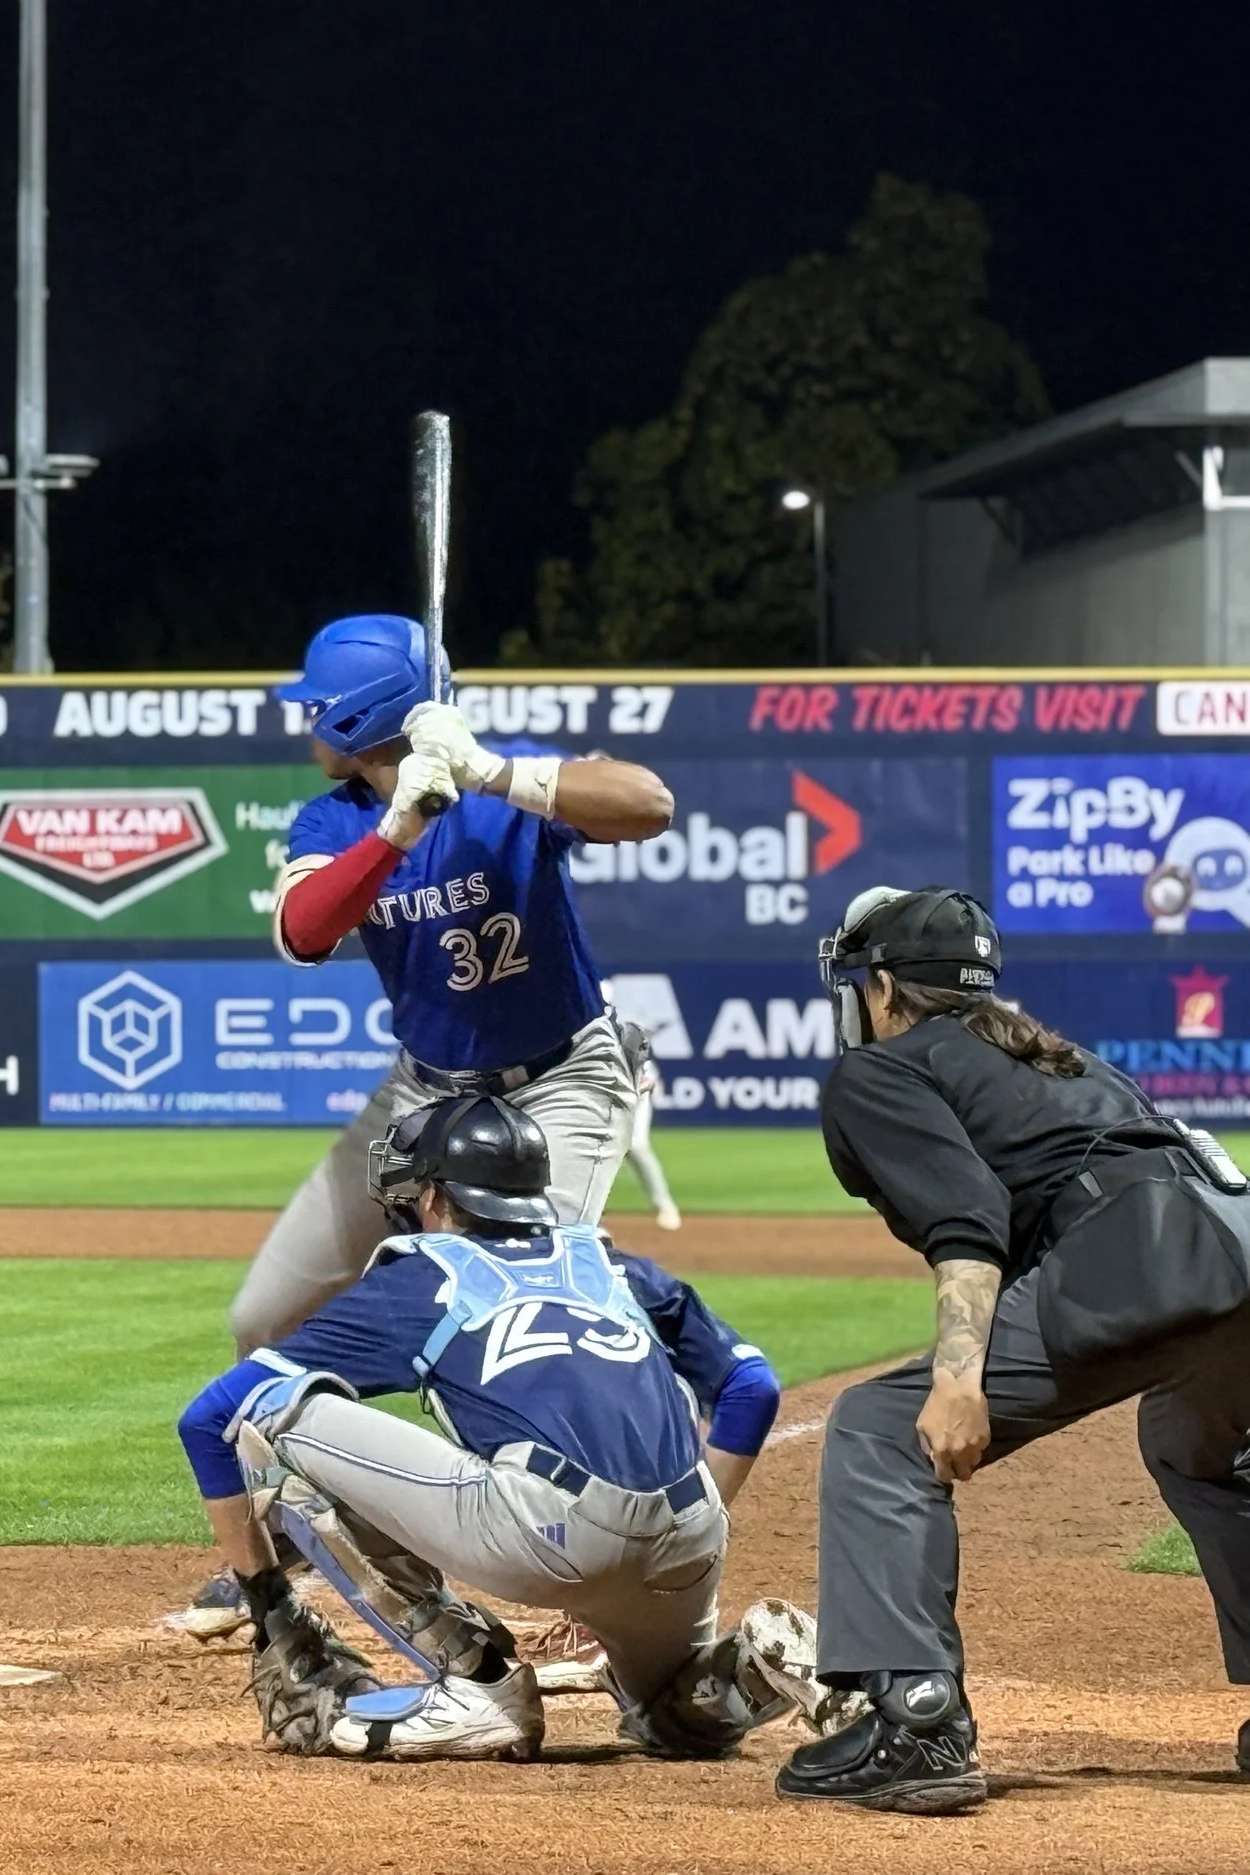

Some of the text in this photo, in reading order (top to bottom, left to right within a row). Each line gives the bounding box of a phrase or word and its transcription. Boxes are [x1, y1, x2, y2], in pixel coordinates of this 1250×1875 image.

[53, 690, 266, 737] AUGUST
[280, 700, 314, 736] 1
[456, 685, 597, 734] GUST
[608, 685, 674, 734] 27
[750, 685, 1147, 732] FOR TICKETS VISIT
[16, 807, 182, 836] VAN KAM
[1007, 776, 1184, 842] ZipBy
[1007, 846, 1155, 876] Park Like
[745, 883, 808, 925] BC
[1007, 880, 1093, 907] a Pro
[439, 912, 529, 992] 32
[708, 1076, 821, 1110] YOUR
